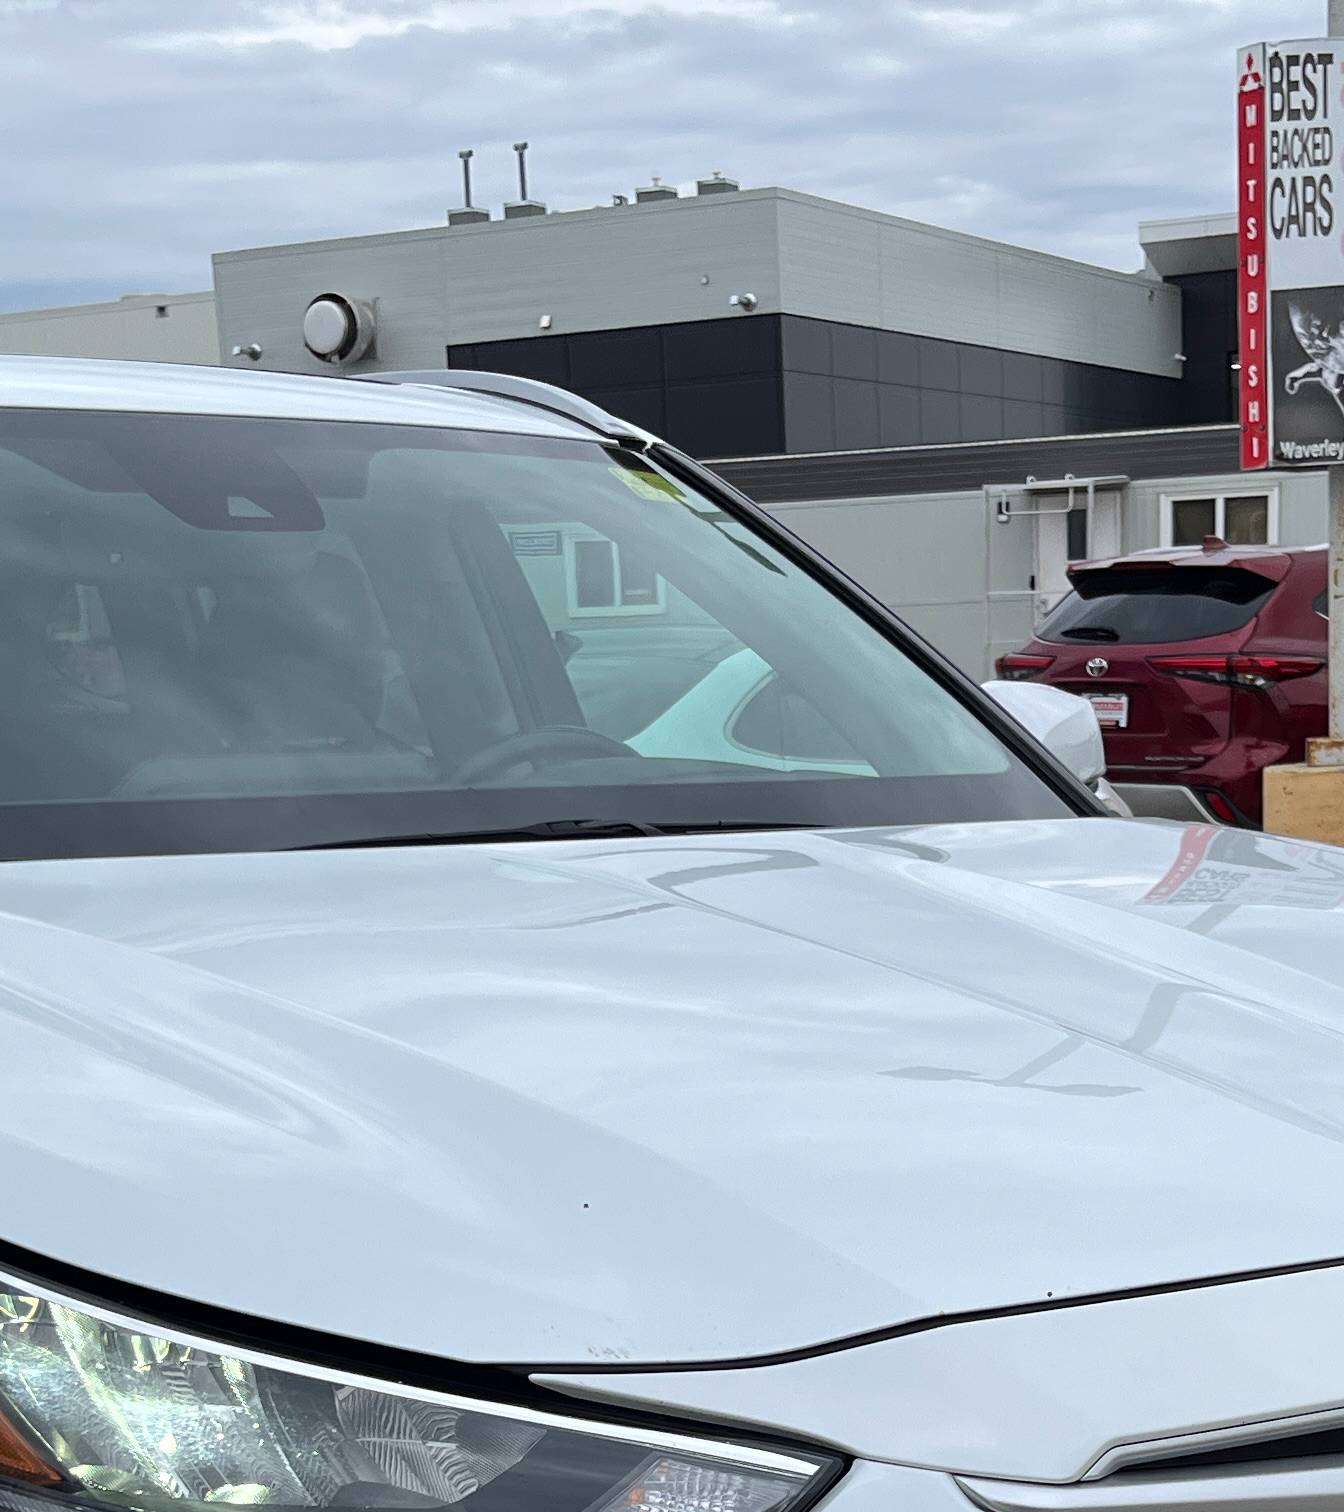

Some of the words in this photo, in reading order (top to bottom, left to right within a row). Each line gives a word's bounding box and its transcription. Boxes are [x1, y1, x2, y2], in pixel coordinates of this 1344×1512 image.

[1269, 53, 1334, 122] BEST
[1270, 127, 1334, 169] BACKED
[1270, 174, 1334, 240] CARS
[1244, 103, 1260, 459] MITSUBISHI
